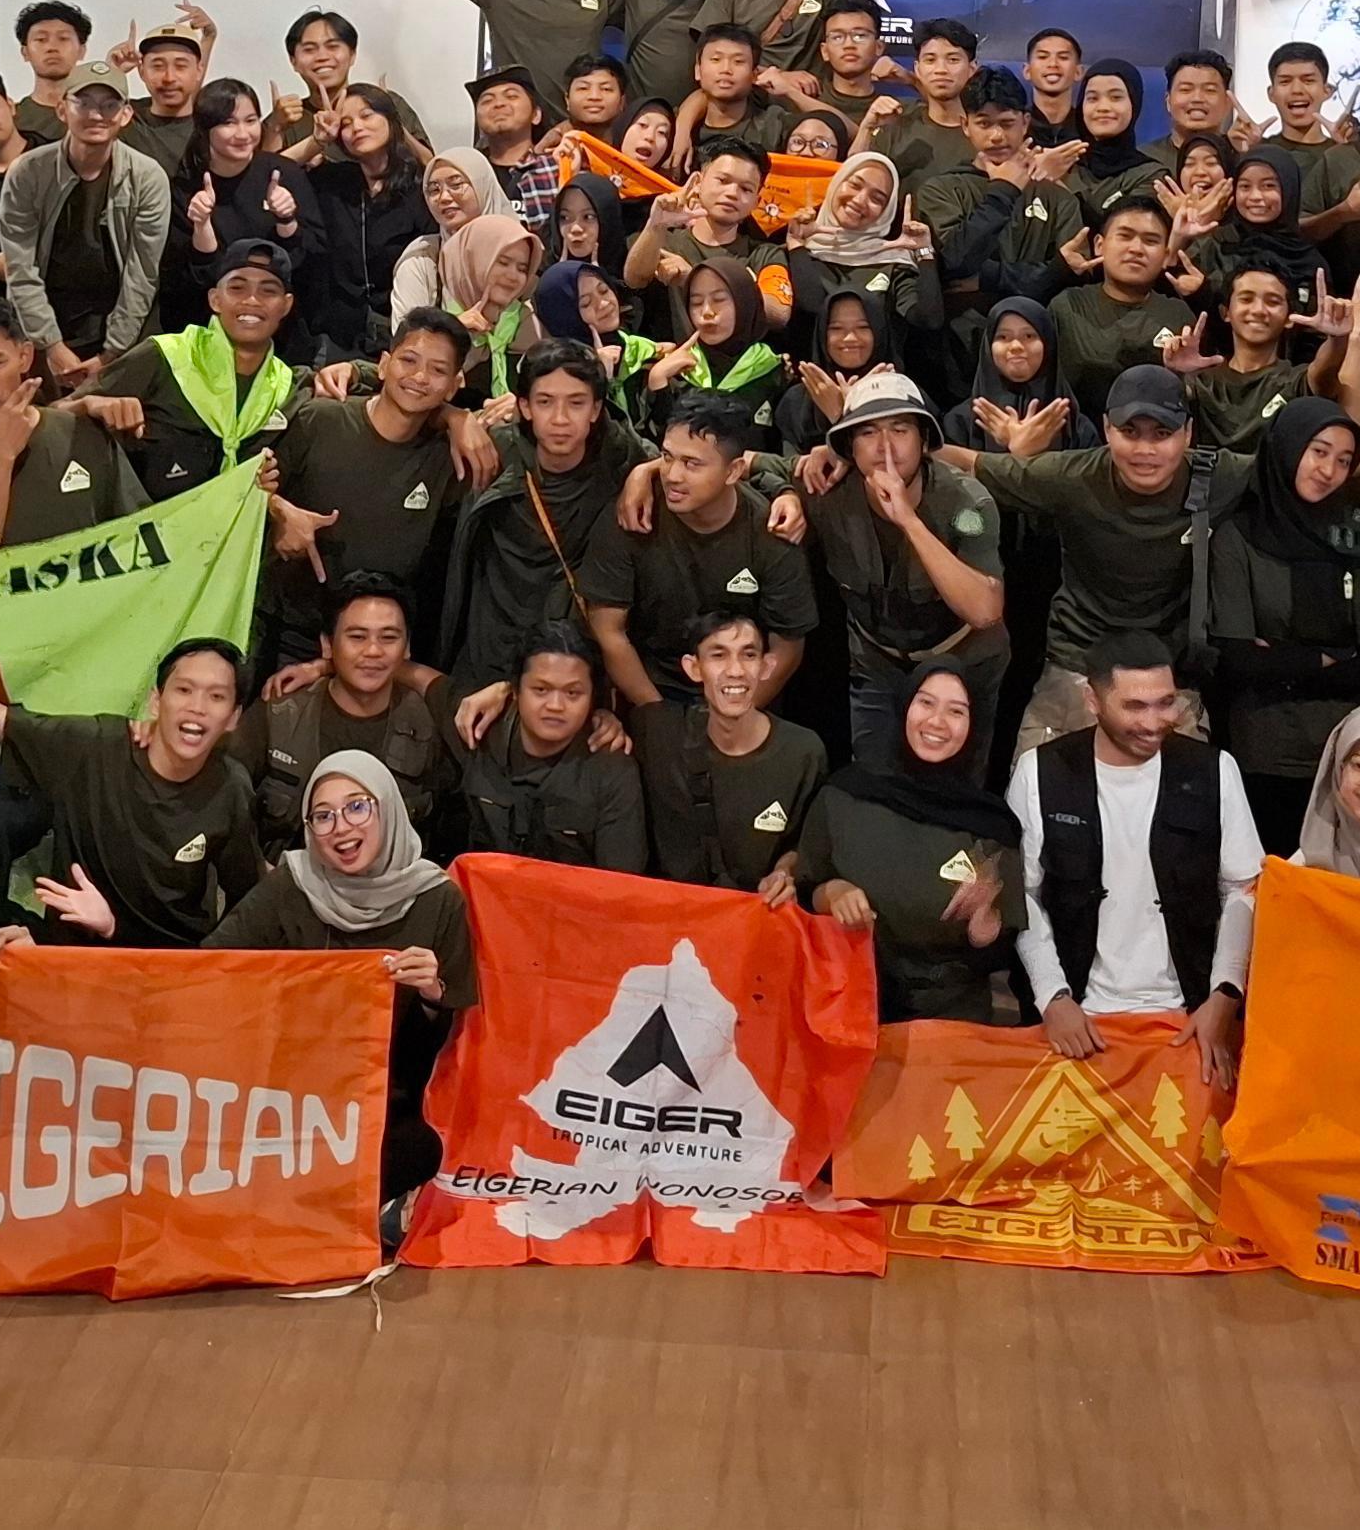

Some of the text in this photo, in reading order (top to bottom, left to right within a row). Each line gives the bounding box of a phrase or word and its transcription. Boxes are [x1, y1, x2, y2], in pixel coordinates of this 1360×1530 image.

[555, 1088, 743, 1140] EIGER
[551, 1127, 743, 1163] TROPICAL ADVENTURE
[451, 1165, 806, 1204] EIGERIAN WONOSOB
[1315, 1243, 1360, 1274] SMA
